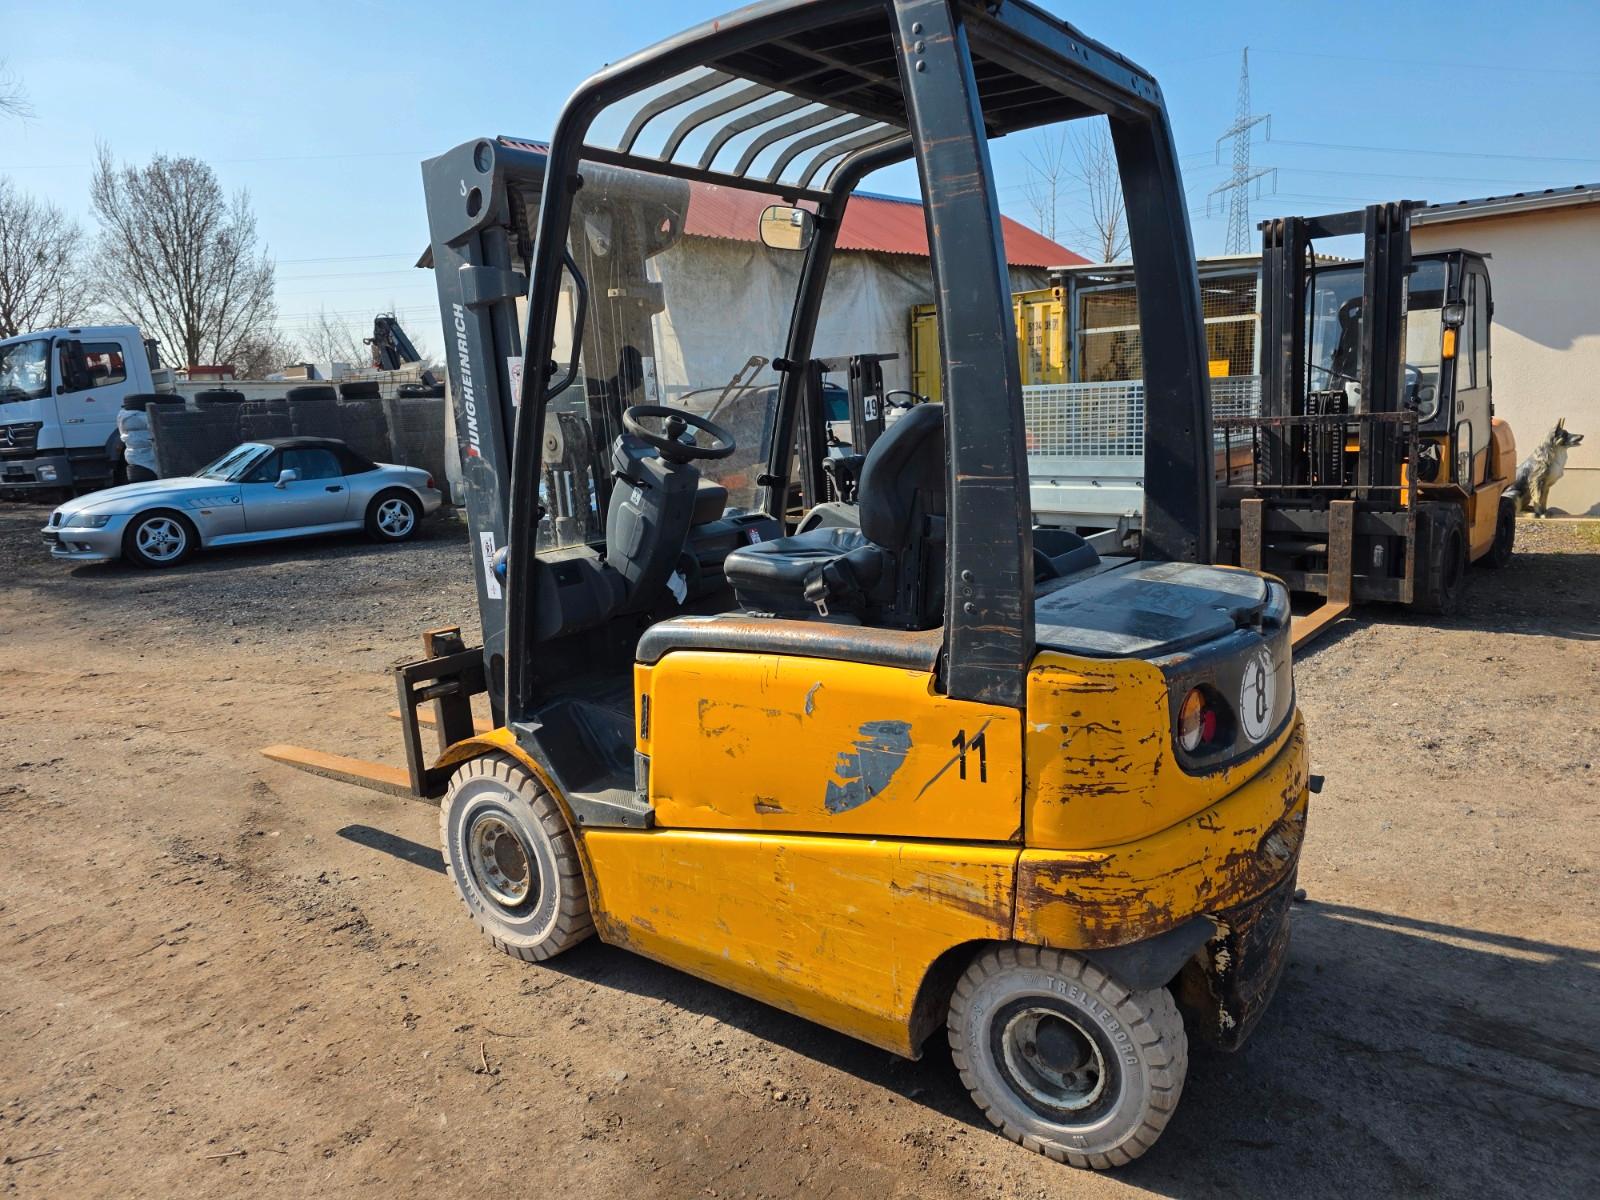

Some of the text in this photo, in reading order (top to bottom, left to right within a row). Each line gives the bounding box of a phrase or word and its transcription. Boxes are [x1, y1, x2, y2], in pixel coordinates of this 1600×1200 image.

[453, 303, 481, 458] JUNGHEINRICH
[866, 399, 877, 418] 49
[952, 729, 987, 783] 11
[1046, 975, 1138, 1066] TRELLEBORG
